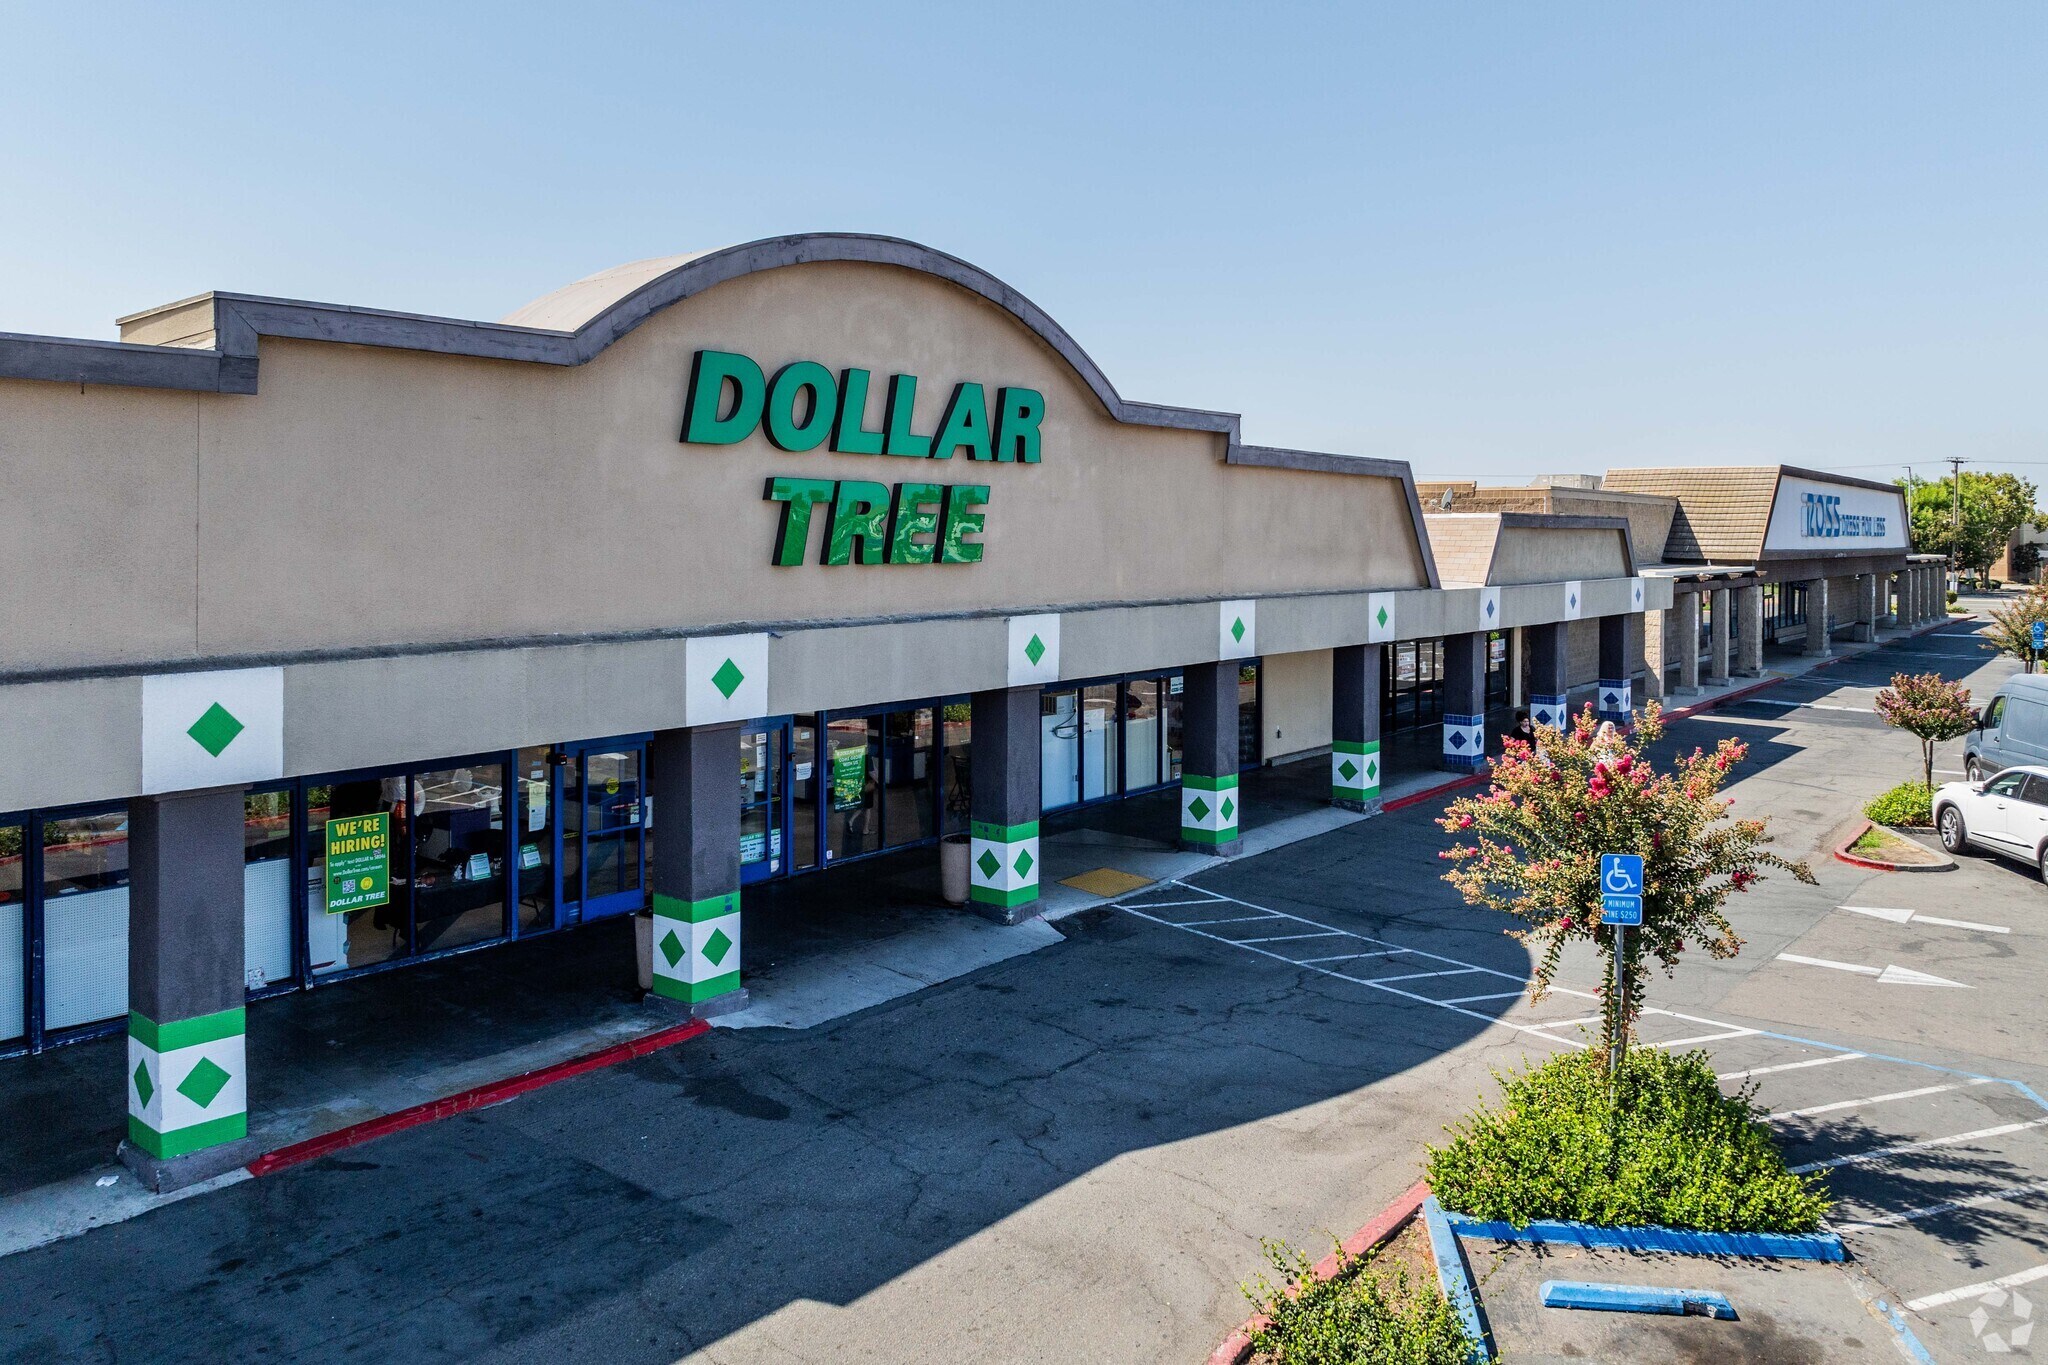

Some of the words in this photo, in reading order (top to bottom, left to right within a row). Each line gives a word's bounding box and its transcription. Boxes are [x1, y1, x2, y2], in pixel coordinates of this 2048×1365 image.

[679, 350, 1046, 464] DOLLAR
[762, 476, 991, 567] TREE
[1801, 492, 1840, 538] ROSS
[336, 818, 380, 837] WE'RE
[331, 833, 385, 856] HIRING!
[330, 895, 364, 908] DOLLAR
[365, 891, 386, 901] TREE
[1608, 899, 1635, 908] MINIMUM
